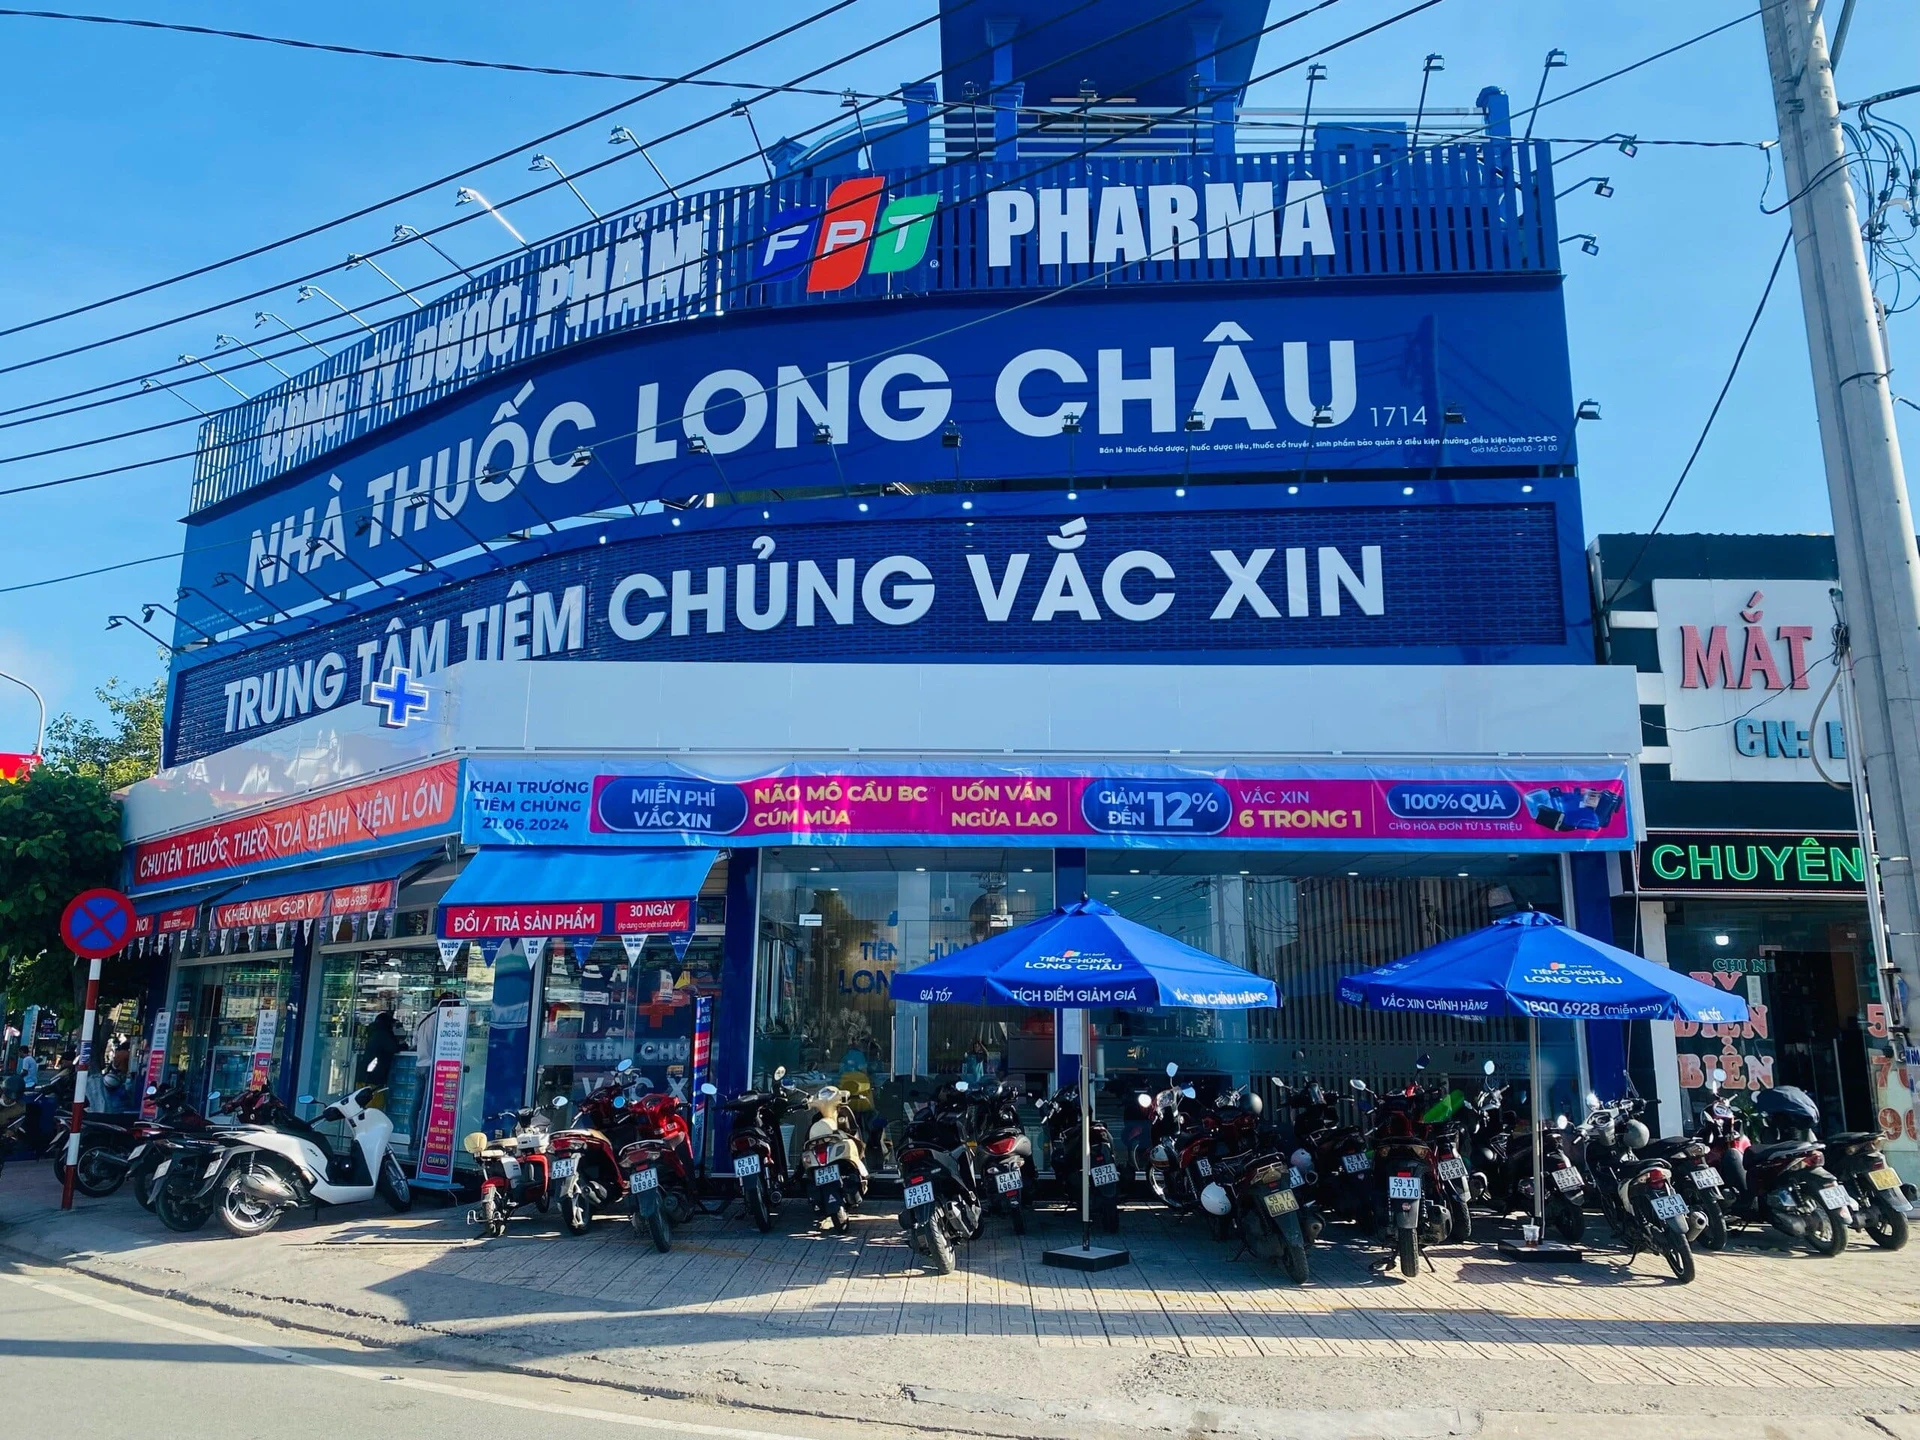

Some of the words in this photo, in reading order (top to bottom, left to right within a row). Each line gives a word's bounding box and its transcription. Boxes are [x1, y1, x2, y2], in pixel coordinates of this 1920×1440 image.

[988, 179, 1336, 267] PHARMA
[261, 380, 348, 467] CÔNG
[534, 211, 703, 340] PHẨM
[1370, 405, 1428, 428] 1714
[245, 473, 347, 595] NHÀ
[367, 379, 596, 548] THUỐC
[635, 353, 952, 465] LONG
[995, 321, 1358, 439] CHÂU
[225, 652, 347, 732] TRUNG
[357, 617, 449, 700] TÂM
[461, 580, 586, 660] TIÊM
[608, 535, 936, 641] CHỦNG
[965, 516, 1177, 622] VẮC
[1210, 545, 1385, 621] XIN
[1680, 590, 1813, 690] MẮT
[470, 780, 512, 794] KHAI
[517, 780, 589, 795] TRƯƠNG
[631, 782, 681, 805] MIỄN
[684, 787, 716, 807] PHÍ
[754, 784, 800, 805] NÃO
[806, 781, 844, 801] MÔ
[847, 779, 893, 802] CẦU
[952, 779, 1003, 801] UỐN
[1009, 781, 1051, 801] VÁN
[1099, 785, 1145, 806] GIẢM
[1240, 786, 1277, 805] VẮC
[1280, 790, 1310, 804] XIN
[474, 796, 517, 813] TIÊM
[521, 796, 581, 813] CHỦNG
[1147, 791, 1219, 828] 12%
[1402, 793, 1459, 810] 100%
[1461, 789, 1507, 813] QUÀ
[140, 841, 183, 877] CHUYÊN
[187, 827, 229, 867] THUỐC
[233, 831, 269, 857] THEO
[273, 819, 302, 848] TOA
[307, 803, 349, 849] BỆNH
[355, 792, 396, 834] VIỆN
[401, 774, 444, 822] LỚN
[482, 817, 570, 831] 21.06.2024
[633, 804, 676, 828] VẮC
[677, 813, 711, 829] XIN
[754, 806, 797, 828] CÚM
[803, 805, 851, 826] MÙA
[952, 809, 1011, 828] NGỪA
[1016, 812, 1058, 828] LAO
[1107, 806, 1145, 826] ĐẾN
[1238, 809, 1254, 828] 6
[1258, 809, 1348, 829] TRONG
[1351, 810, 1362, 828] 1
[1389, 822, 1411, 831] CHO
[1413, 820, 1436, 831] HÓA
[1438, 821, 1461, 831] ĐƠN
[1464, 821, 1479, 831] TỪ
[1494, 822, 1523, 833] TRIỆU
[1652, 837, 1864, 882] CHUYÊN
[454, 910, 479, 932] ĐỔI
[482, 916, 489, 931] /
[493, 909, 521, 931] TRẢ
[524, 909, 552, 931] SẢN
[555, 906, 595, 930] PHẨM
[630, 905, 642, 917] 30
[645, 901, 676, 916] NGÀY
[1025, 962, 1072, 970] LONG
[1076, 962, 1122, 970] CHÂU
[1712, 958, 1748, 972] CHI
[838, 969, 896, 994] LON
[1524, 975, 1572, 984] LONG
[1576, 975, 1623, 984] CHÂU
[920, 987, 933, 1001] GIÁ
[936, 987, 952, 1001] TỐT
[1011, 987, 1040, 1002] TÍCH
[1044, 985, 1074, 1002] ĐIỂM
[1077, 987, 1111, 1002] GIẢM
[1114, 987, 1137, 1000] GIÁ
[1208, 991, 1238, 1004] CHÍNH
[1381, 993, 1405, 1008] VẮC
[1407, 999, 1425, 1009] XIN
[1426, 998, 1458, 1011] CHÍNH
[1524, 1000, 1558, 1014] 1800
[1562, 1002, 1600, 1015] 6928
[1604, 1003, 1638, 1015] (miễn
[1677, 1043, 1774, 1090] BIÊN
[634, 1170, 653, 1182] 62-F1
[1393, 1178, 1415, 1188] 59-X1
